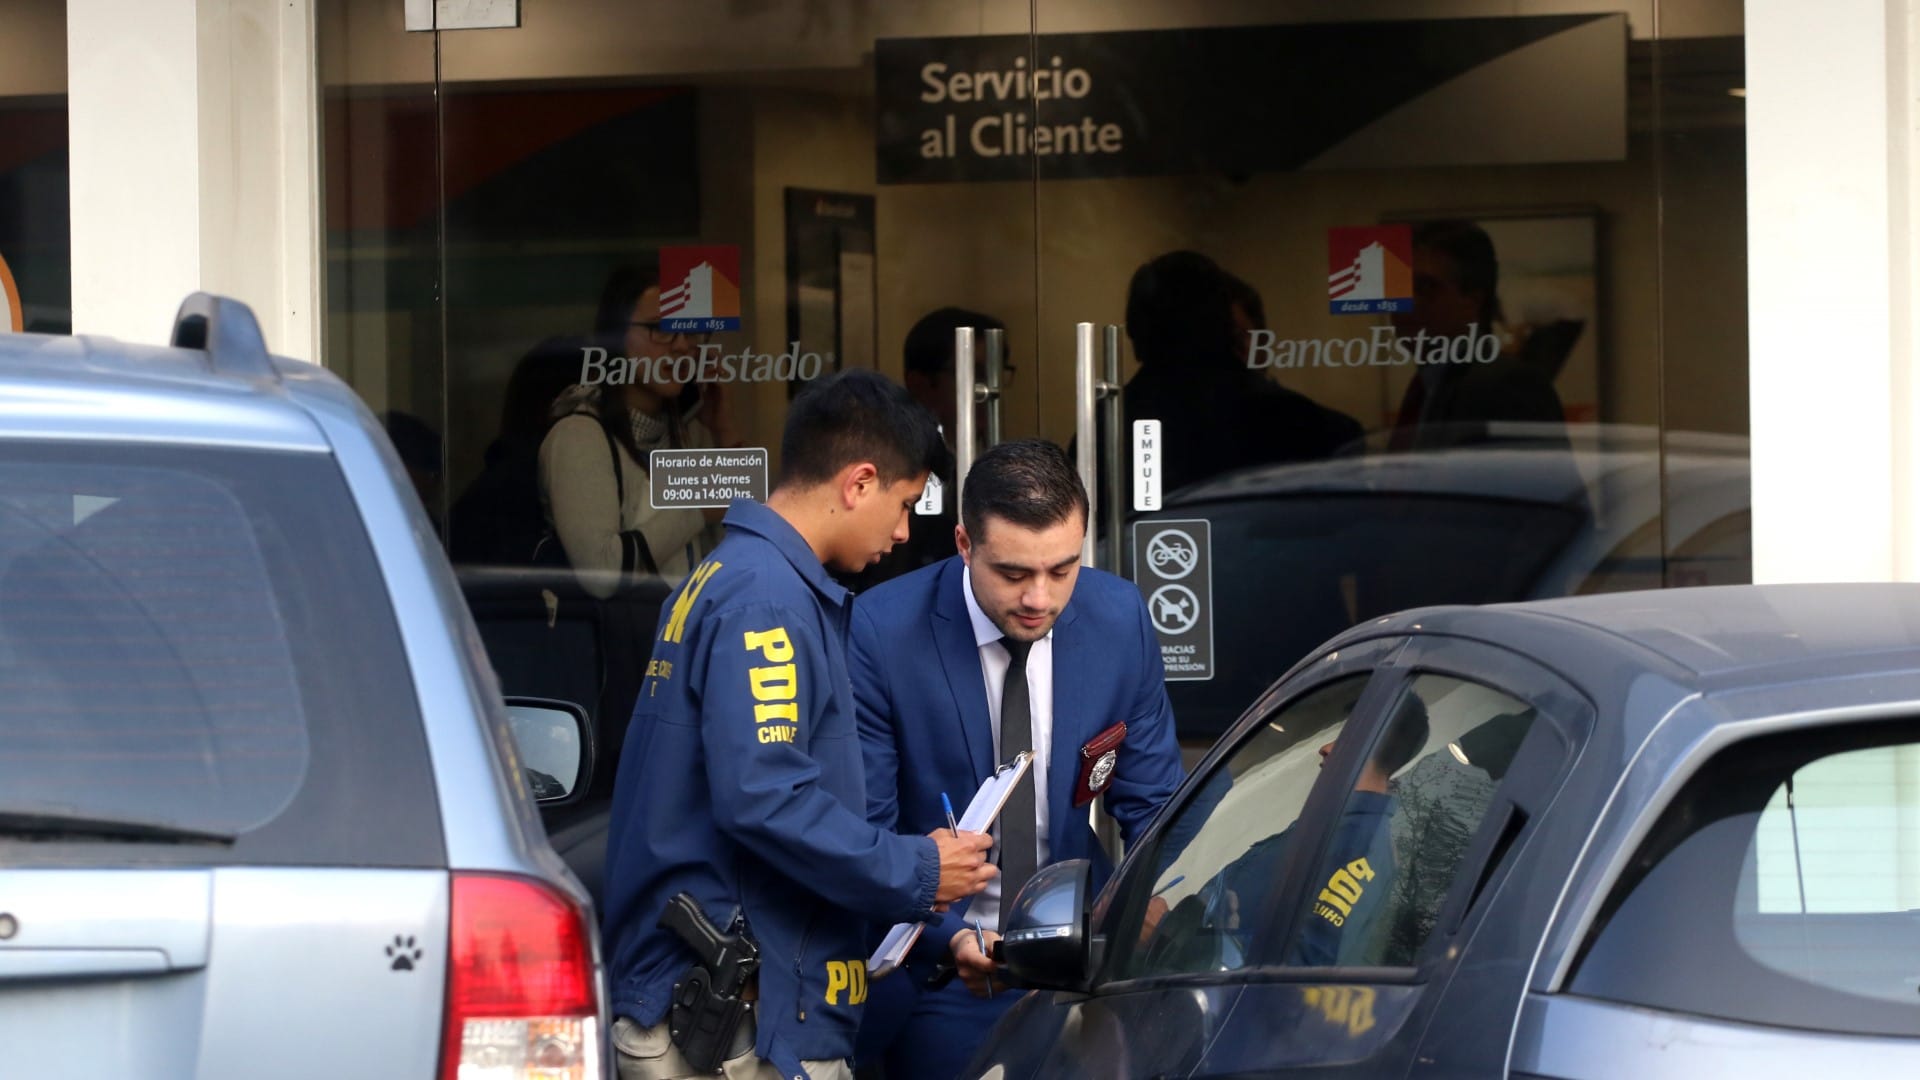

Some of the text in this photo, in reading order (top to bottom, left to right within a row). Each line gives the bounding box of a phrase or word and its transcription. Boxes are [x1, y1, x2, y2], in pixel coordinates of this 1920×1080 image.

[921, 56, 1092, 103] Servicio
[920, 112, 1123, 158] al Cliente
[1341, 300, 1398, 312] desde 1855
[671, 319, 726, 331] desde 1855
[1246, 322, 1502, 369] BancoEstado
[580, 341, 822, 386] BancoEstado
[656, 454, 762, 468] Horario de Atención
[1141, 424, 1153, 507] EMPUJE
[667, 473, 751, 486] Lunes a Viernes
[663, 487, 755, 501] 09:00 a 14:00 hrs.
[1160, 645, 1196, 655] RACIAS
[1164, 662, 1206, 672] PRENSIÓN
[743, 626, 799, 724] PDI
